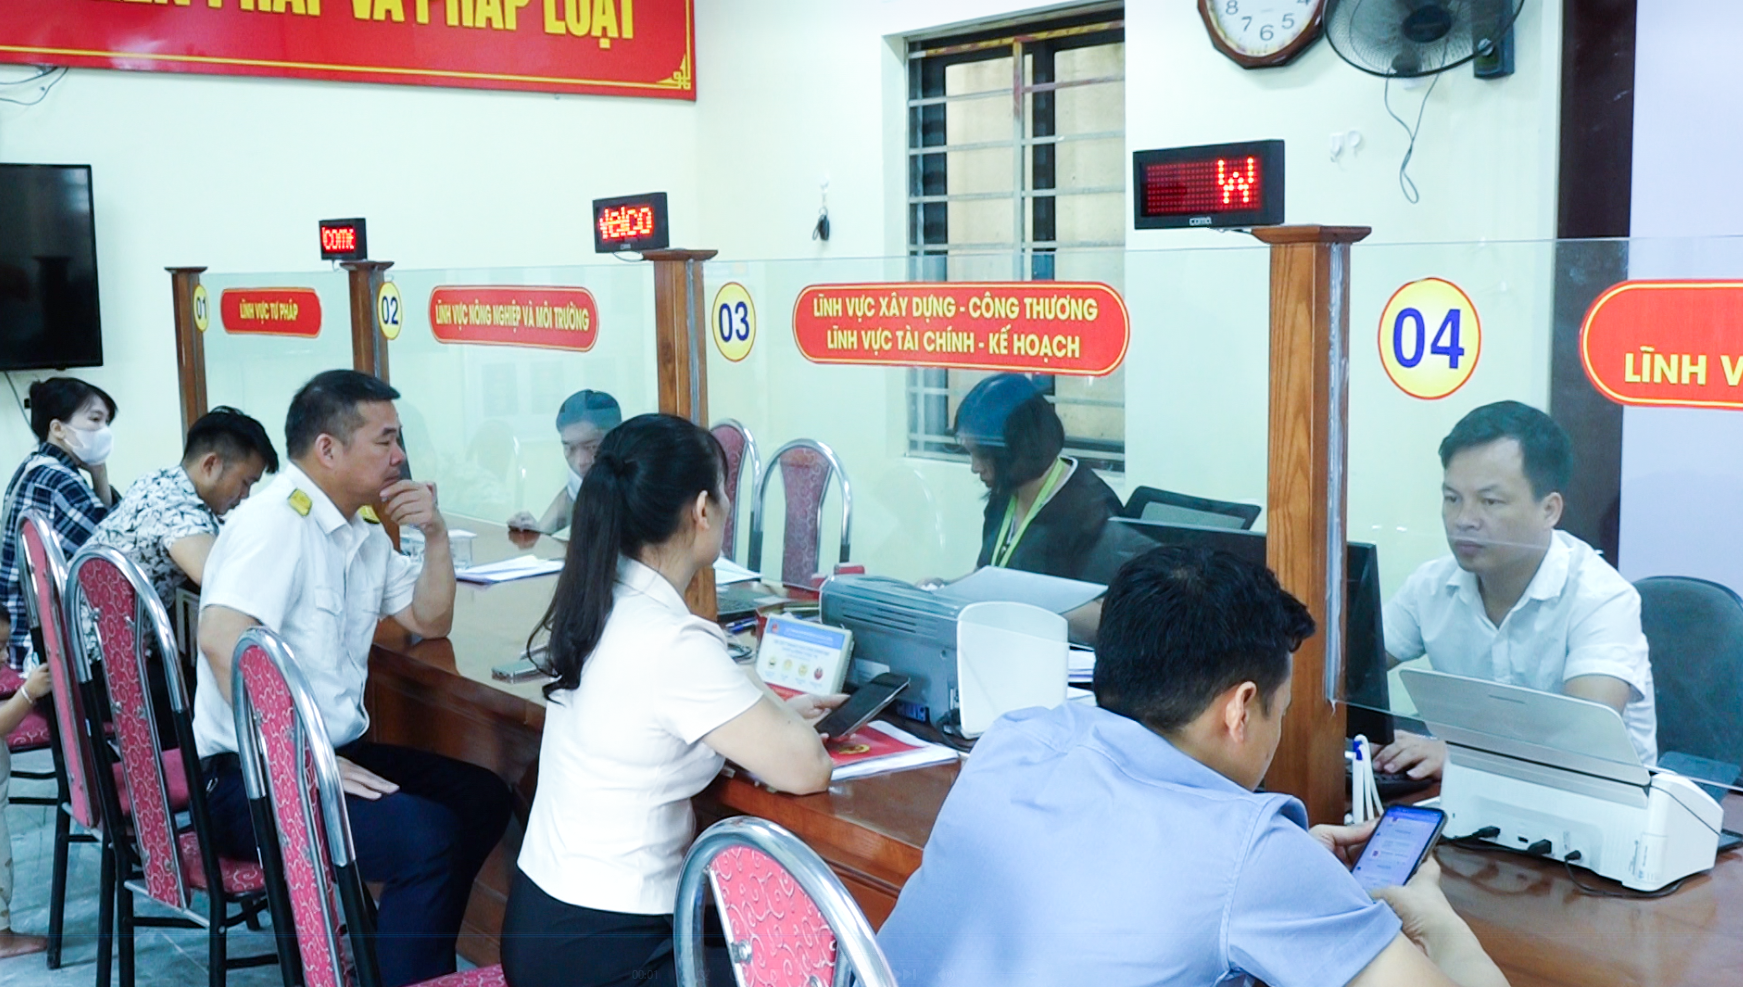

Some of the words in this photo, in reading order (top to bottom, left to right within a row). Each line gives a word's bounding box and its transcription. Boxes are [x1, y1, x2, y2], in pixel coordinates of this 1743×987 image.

[1225, 0, 1239, 15] 8
[1281, 13, 1295, 30] 5
[1241, 16, 1252, 32] 7
[1259, 24, 1274, 41] 6
[1216, 156, 1255, 205] W
[196, 296, 208, 320] 01
[280, 298, 299, 321] PHÁP
[380, 295, 399, 327] 02
[435, 300, 452, 325] LĨNH
[452, 303, 469, 331] VỰC
[469, 298, 492, 326] NÔNG
[493, 299, 522, 333] NGHIỆP
[523, 301, 536, 328] VÀ
[536, 300, 553, 329] MÔI
[554, 301, 590, 332] TRƯỜNG
[718, 300, 750, 343] 03
[813, 294, 842, 318] LĨNH
[846, 296, 876, 324] VỰC
[879, 292, 909, 318] XÂY
[912, 295, 956, 323] DỰNG
[968, 292, 1021, 320] CÔNG
[1024, 295, 1098, 321] THƯƠNG
[827, 327, 858, 350] LĨNH
[860, 329, 892, 357] VỰC
[896, 327, 919, 352] TÀI
[923, 327, 975, 354] CHÍNH
[988, 323, 1011, 356] KẾ
[1013, 333, 1080, 364] HOẠCH
[1391, 306, 1465, 370] 04
[1624, 346, 1707, 385] LĨNH
